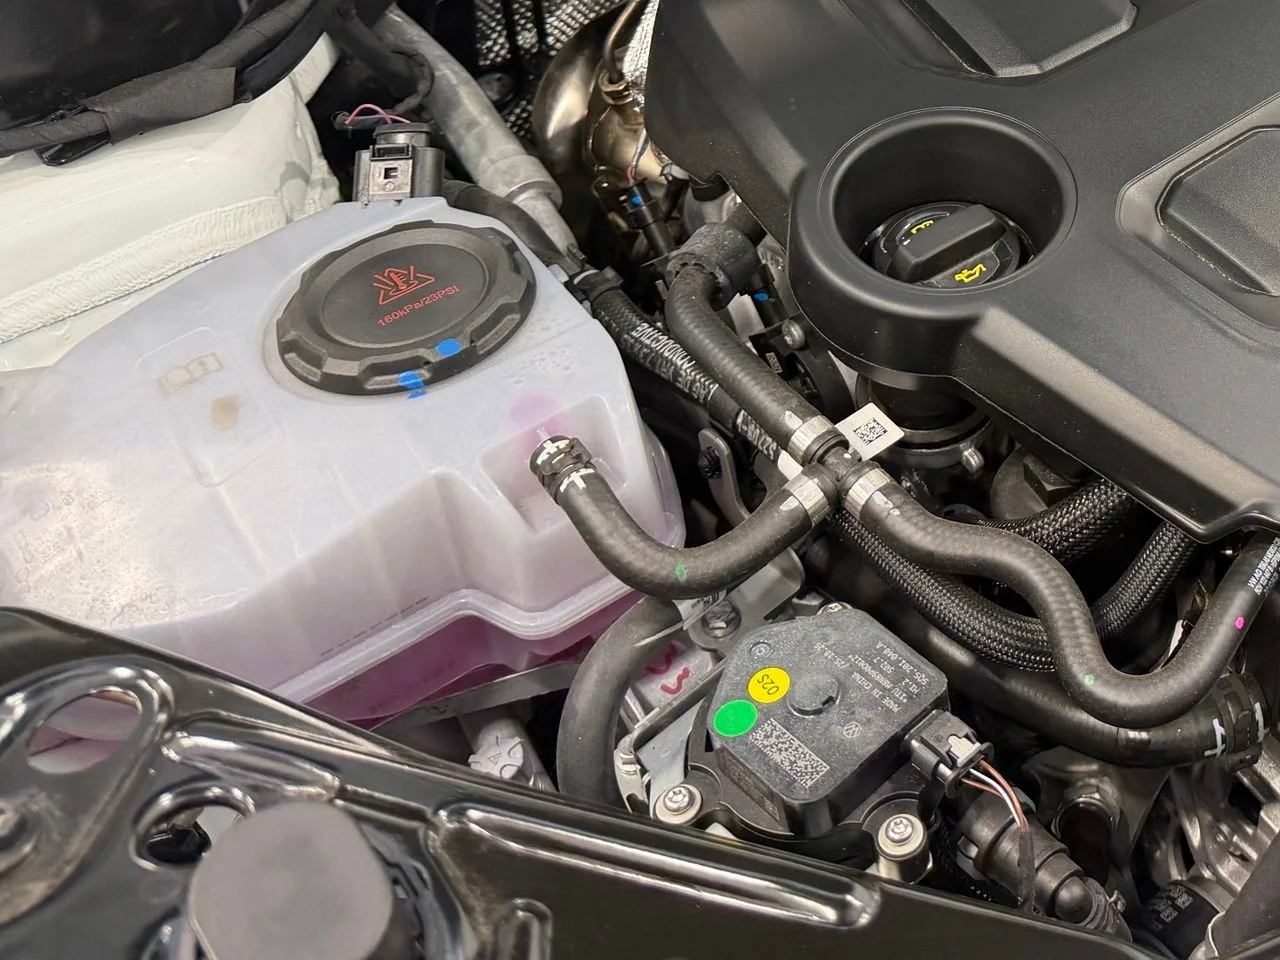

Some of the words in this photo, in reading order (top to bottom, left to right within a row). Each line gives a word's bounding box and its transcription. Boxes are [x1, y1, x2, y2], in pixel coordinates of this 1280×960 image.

[377, 284, 460, 327] 160kPa/23PSI
[851, 670, 873, 690] CHINA
[871, 687, 883, 698] IN
[881, 695, 901, 712] MADE
